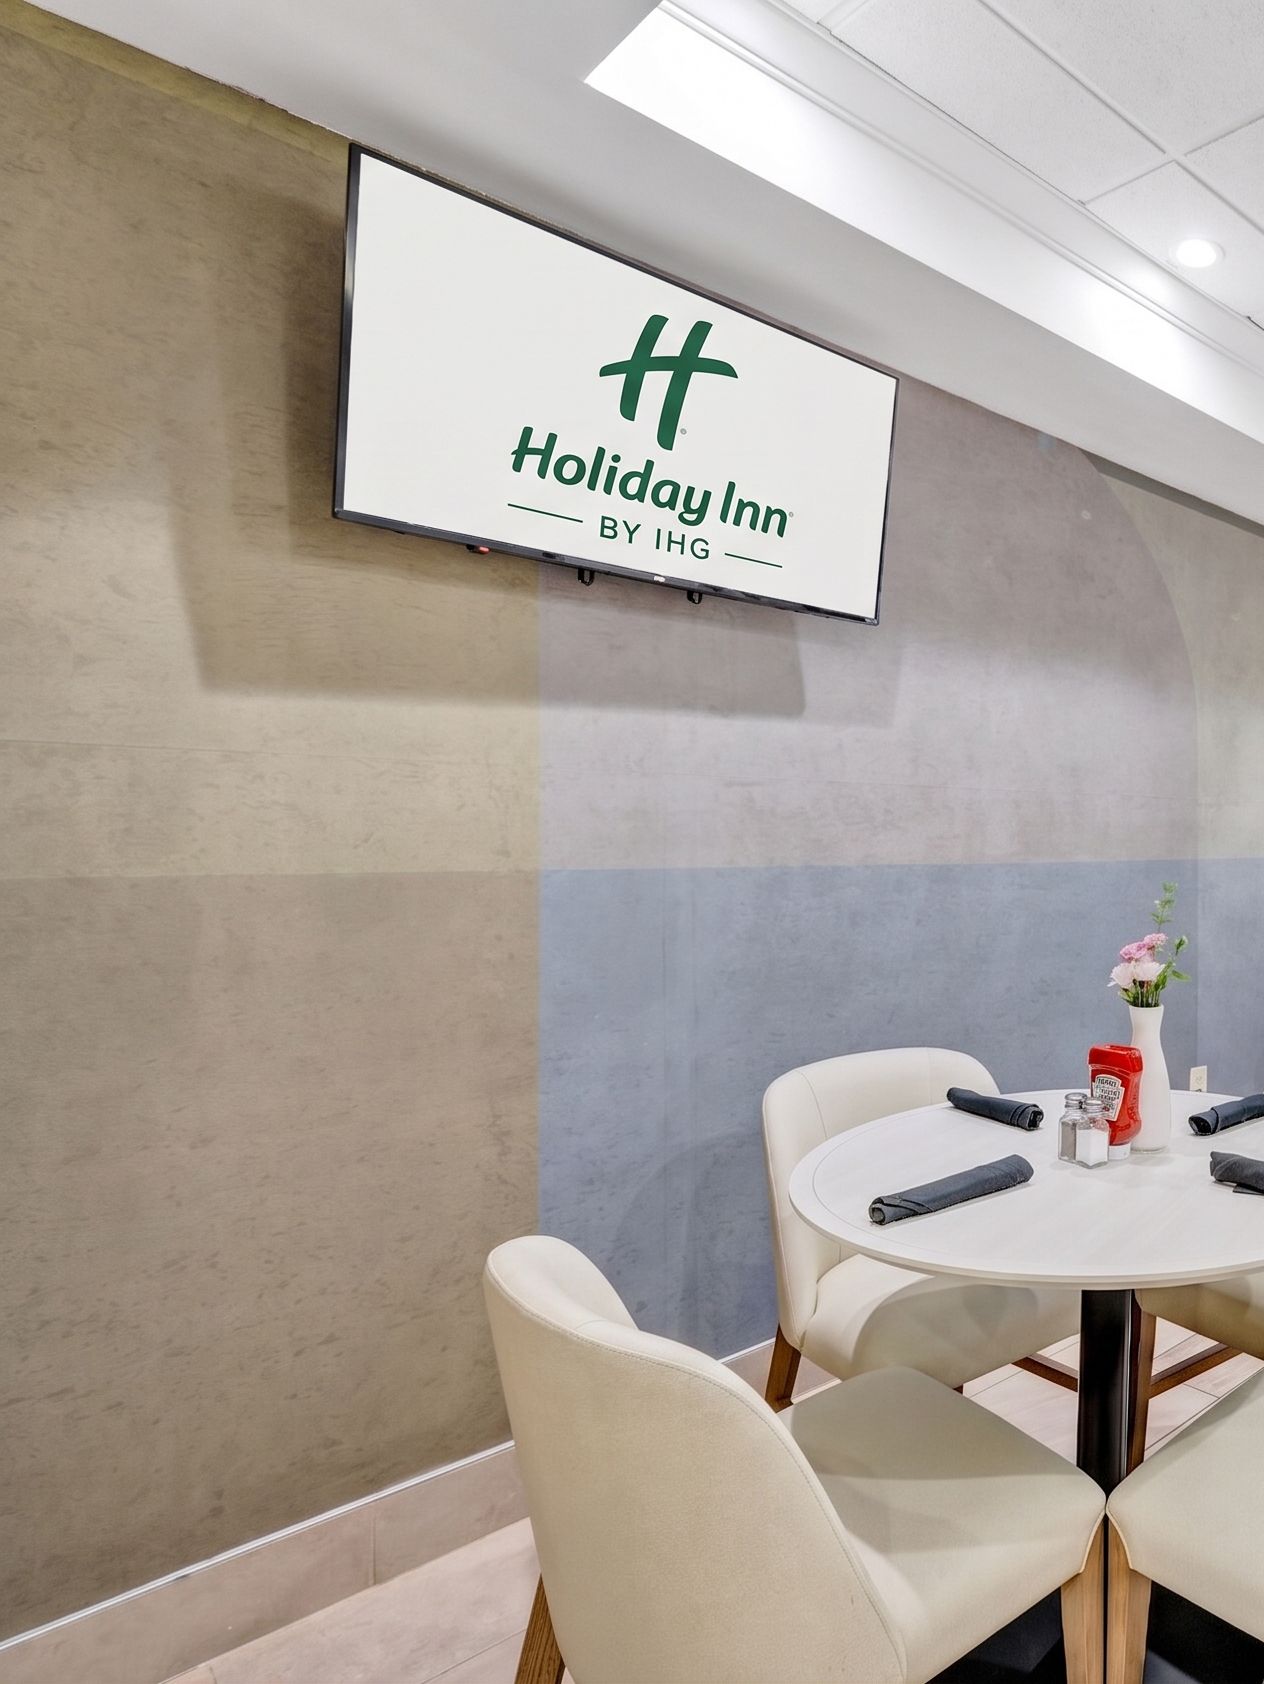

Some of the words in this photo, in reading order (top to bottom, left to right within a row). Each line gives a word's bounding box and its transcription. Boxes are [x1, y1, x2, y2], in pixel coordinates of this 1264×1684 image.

[511, 426, 712, 527] Holiday
[719, 480, 788, 538] Inn
[599, 515, 642, 545] BY
[655, 528, 711, 560] IHG
